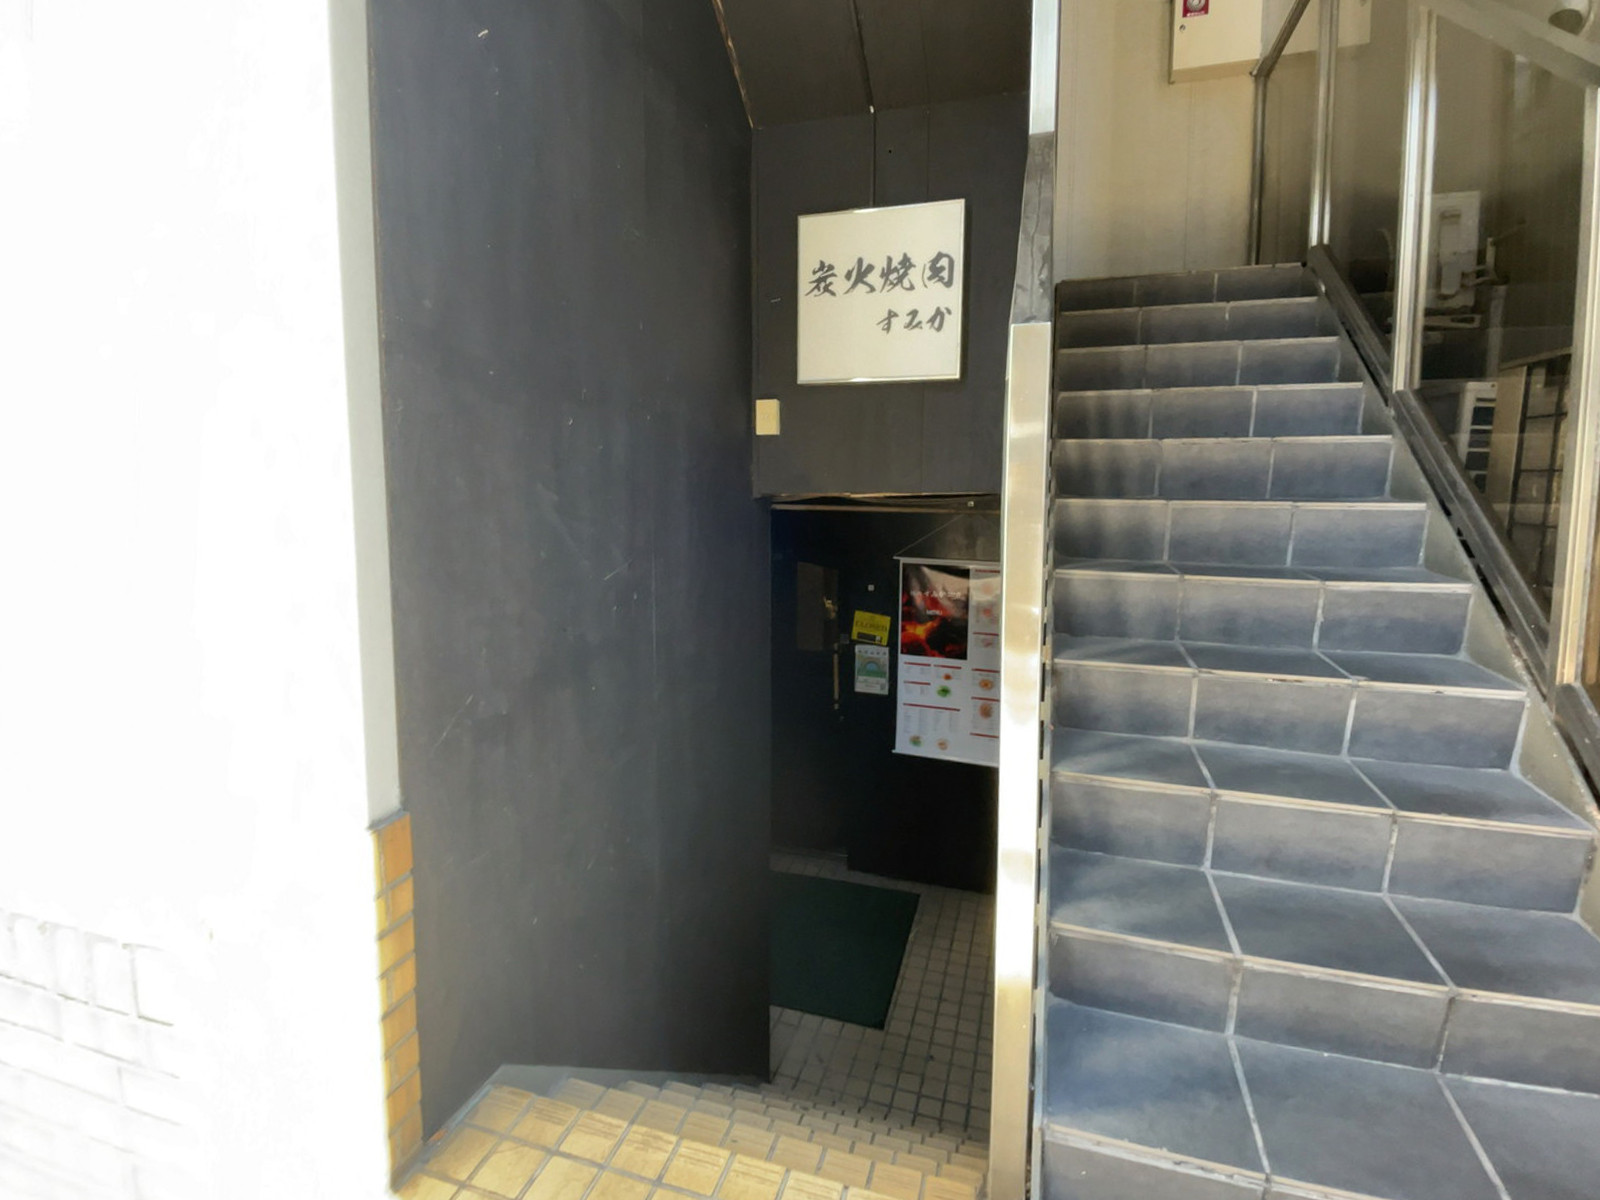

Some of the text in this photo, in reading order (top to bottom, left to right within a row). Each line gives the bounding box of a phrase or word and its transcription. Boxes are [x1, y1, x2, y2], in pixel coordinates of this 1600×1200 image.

[805, 251, 954, 297] 炭火焼肉
[876, 306, 952, 334] すみか
